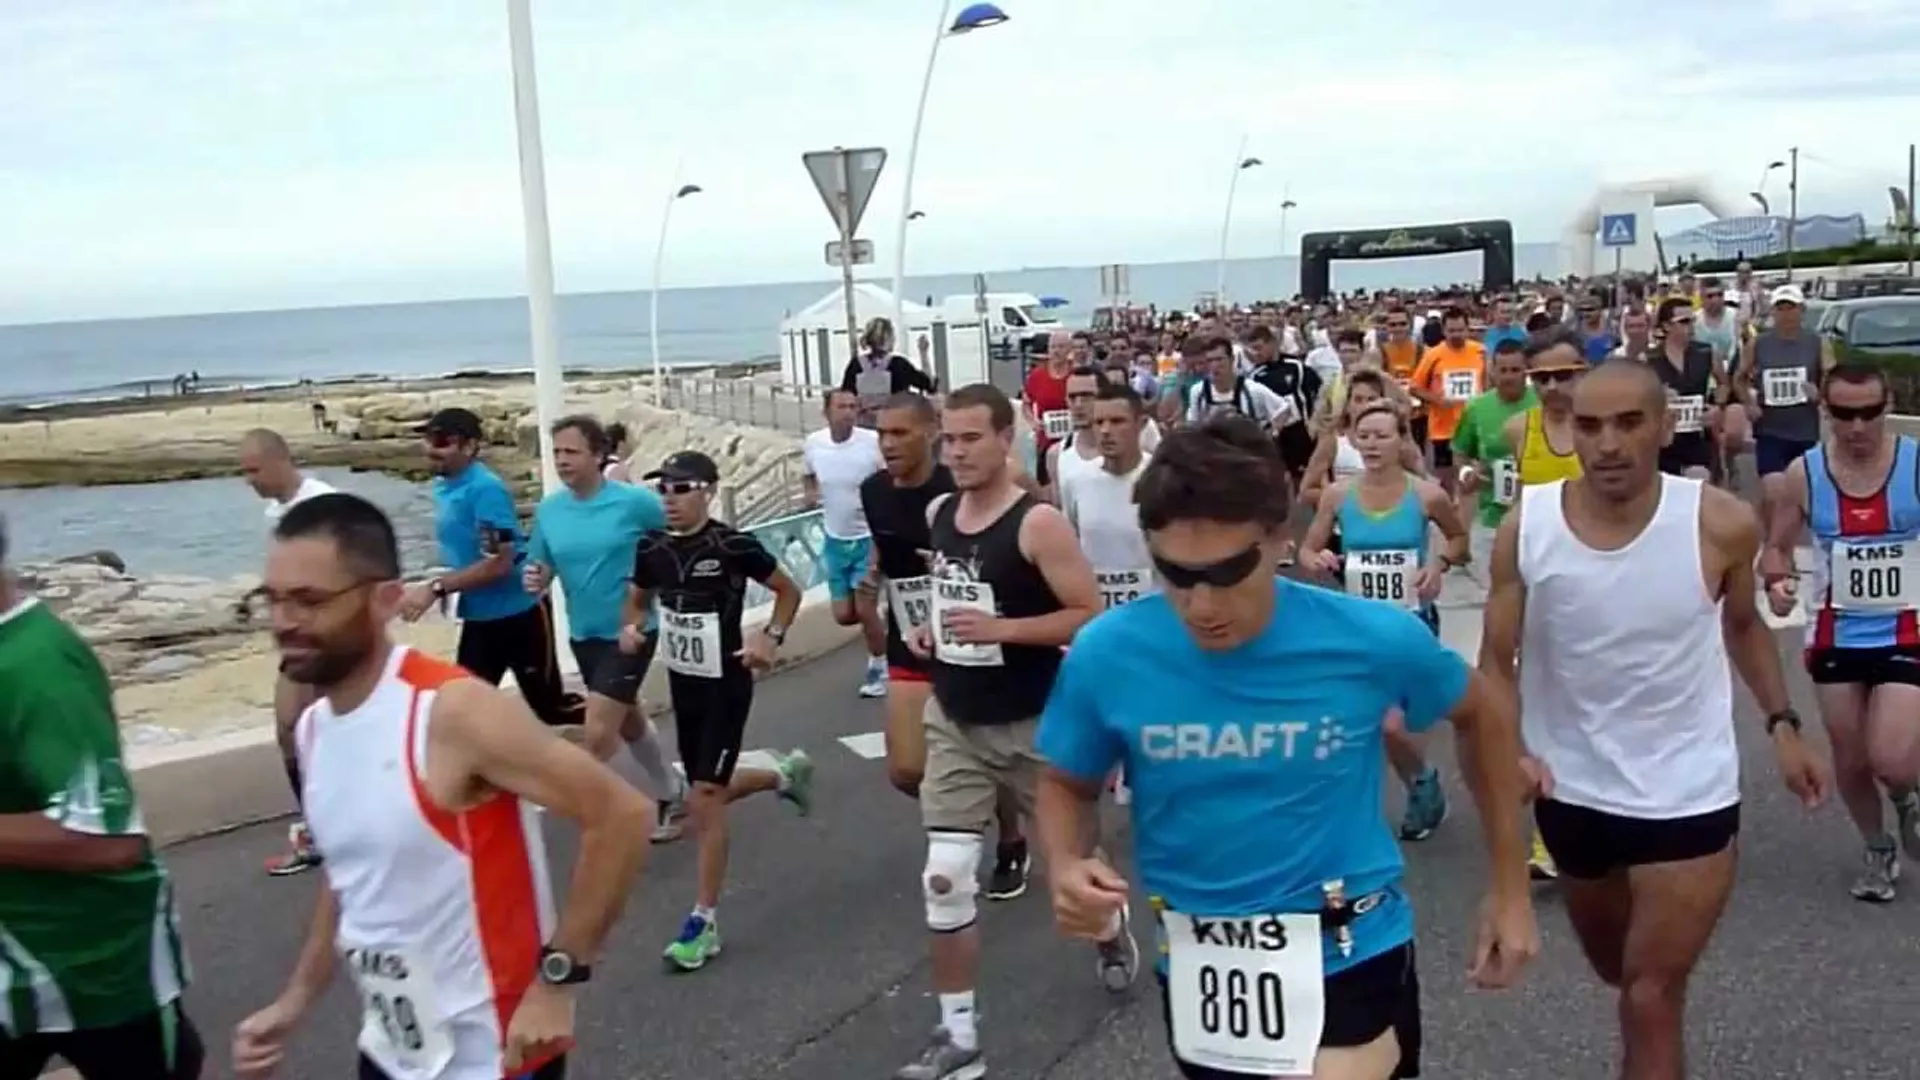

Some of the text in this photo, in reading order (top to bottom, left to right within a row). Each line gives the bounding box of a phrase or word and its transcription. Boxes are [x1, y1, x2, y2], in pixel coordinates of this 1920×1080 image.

[1361, 553, 1405, 565] KMS
[1847, 544, 1904, 561] KMS
[1096, 572, 1139, 585] KMS
[1361, 572, 1404, 600] 998
[1849, 566, 1901, 598] 800
[1141, 721, 1310, 760] CRAFT
[1190, 915, 1287, 951] KMS
[1200, 965, 1285, 1041] 860
